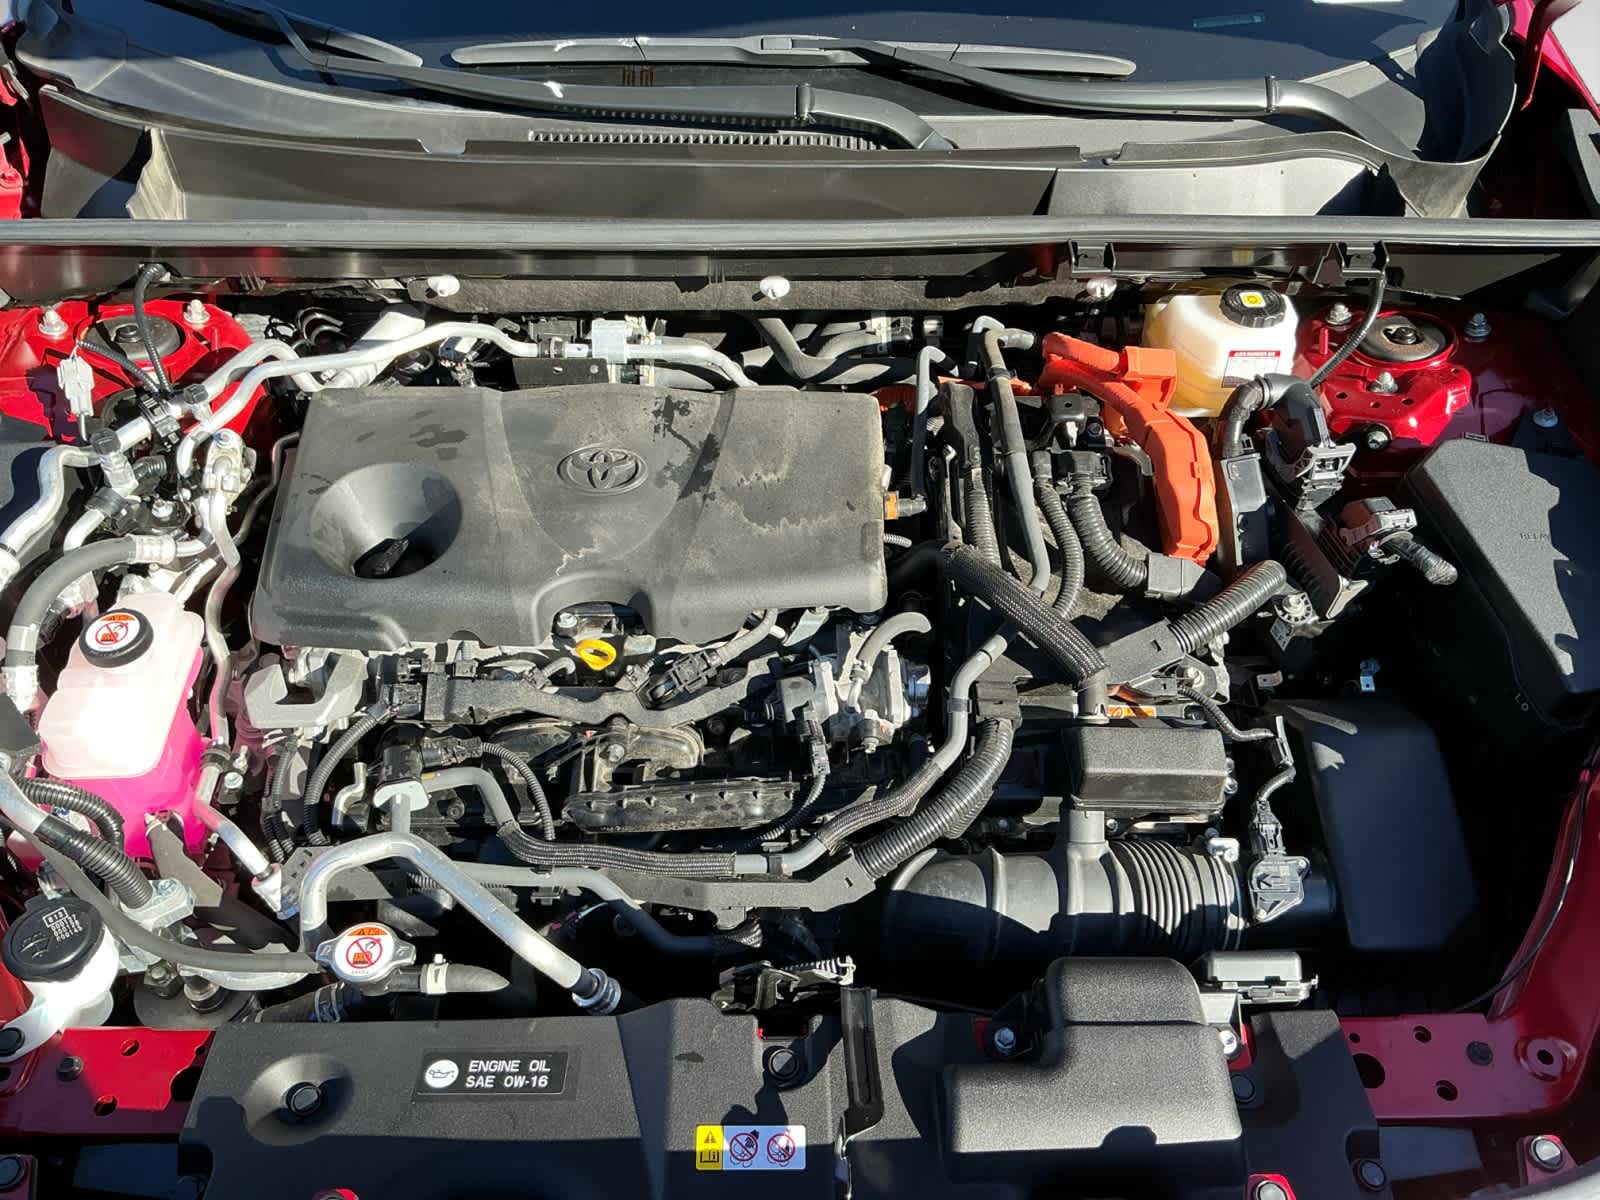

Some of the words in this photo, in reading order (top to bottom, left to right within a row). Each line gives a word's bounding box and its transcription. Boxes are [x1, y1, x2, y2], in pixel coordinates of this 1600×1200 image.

[468, 1059, 520, 1072] ENGINE
[528, 1059, 551, 1072] OIL
[465, 1075, 496, 1088] SAE
[503, 1075, 549, 1088] 0W-16
